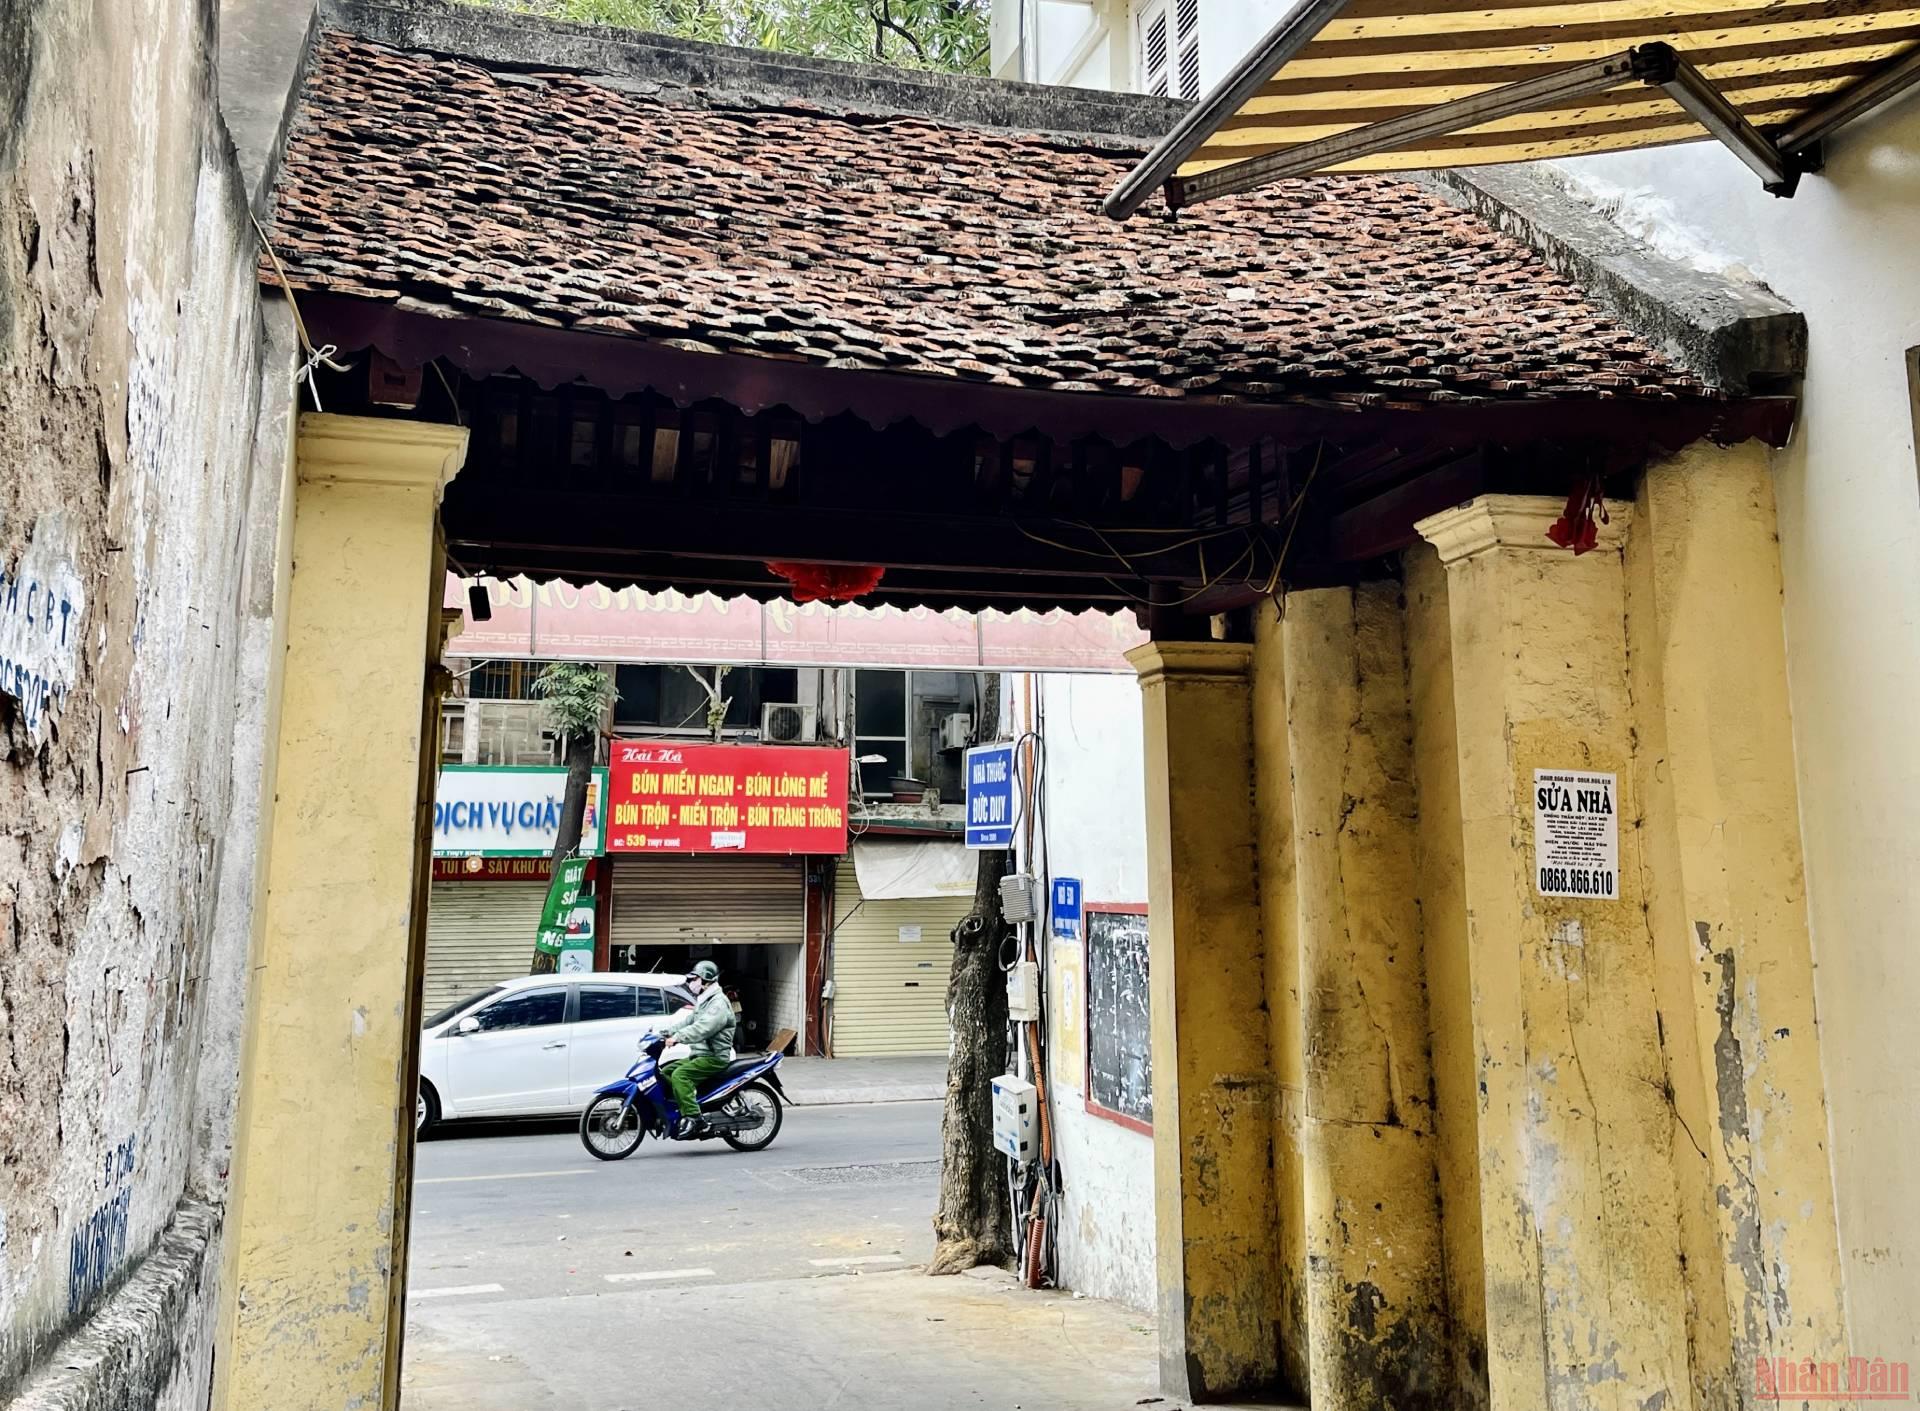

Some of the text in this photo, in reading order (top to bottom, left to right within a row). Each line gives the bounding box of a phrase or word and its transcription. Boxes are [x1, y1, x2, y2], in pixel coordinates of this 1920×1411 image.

[632, 769, 659, 795] BÚN
[699, 775, 734, 797] NGAN
[745, 772, 771, 797] BÚN
[775, 771, 806, 797] LÒNG
[973, 754, 1007, 785] NHÀ THUỐC
[973, 791, 1006, 823] ĐỨC DUY
[1537, 782, 1612, 814] SỬA NHÀ
[488, 802, 515, 836] VỤ
[615, 800, 638, 825] BÚN
[641, 803, 670, 830] TRỘN
[710, 803, 738, 831] TRỘN
[747, 801, 769, 826] BÚN
[626, 834, 646, 847] 539
[1540, 868, 1612, 895] 0868.866.610
